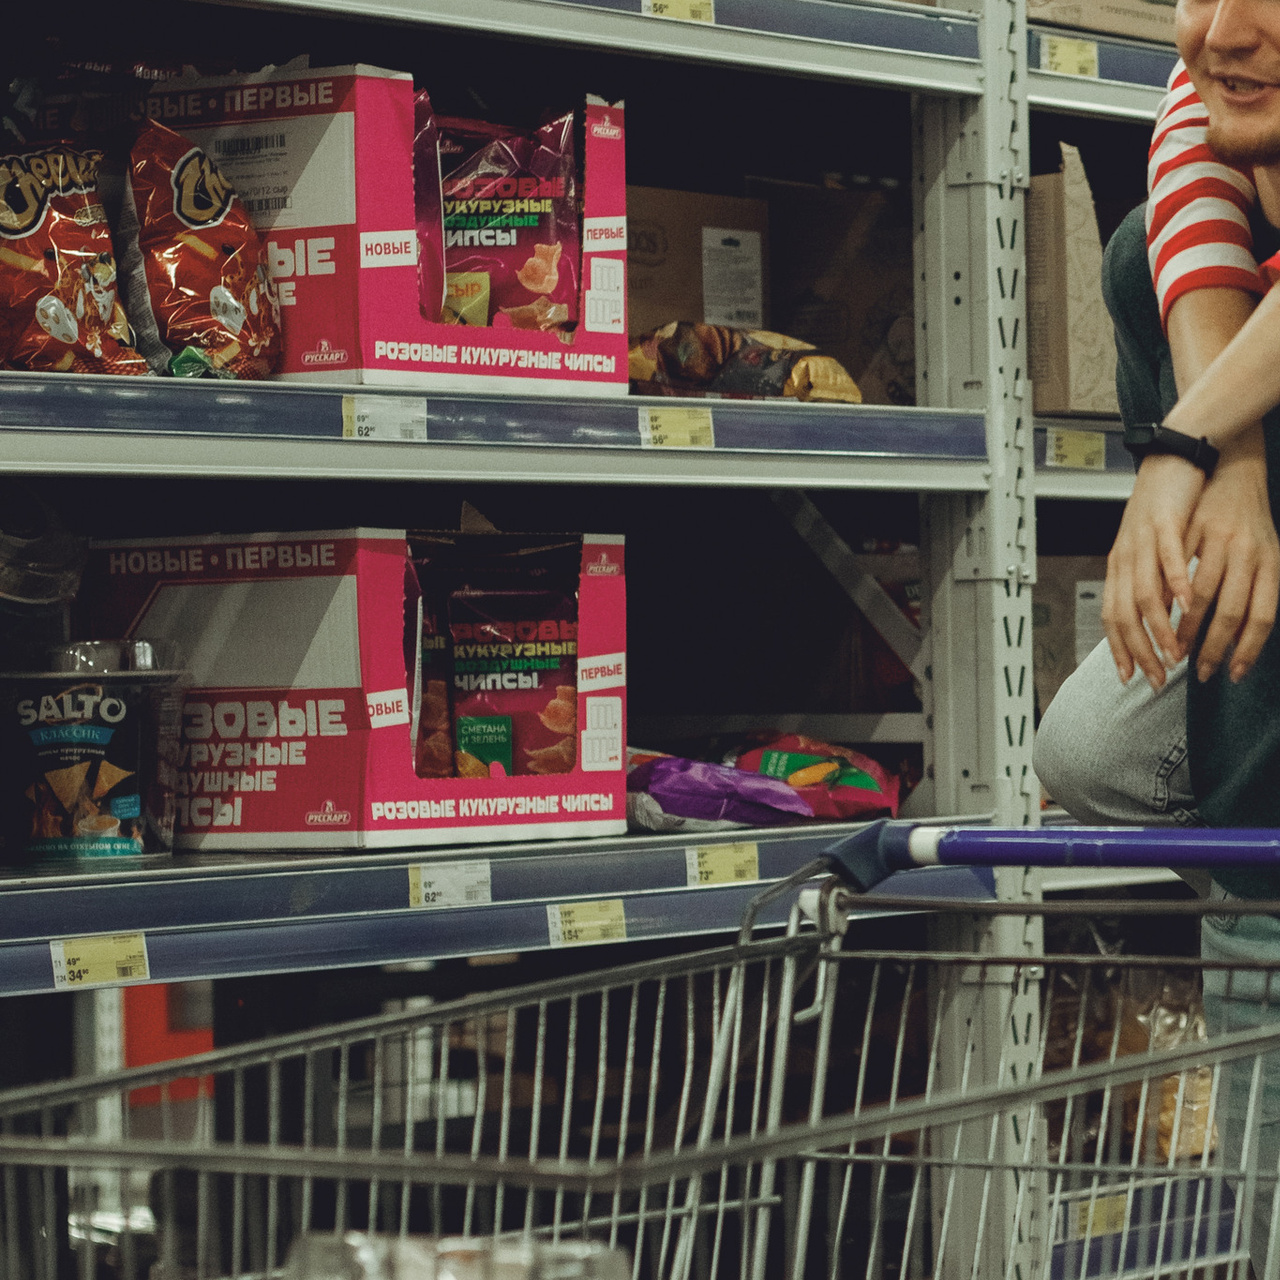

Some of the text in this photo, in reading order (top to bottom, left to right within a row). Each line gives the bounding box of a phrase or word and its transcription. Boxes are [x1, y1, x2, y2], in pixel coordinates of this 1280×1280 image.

[224, 81, 334, 113] ПЕРВЫЕ
[444, 199, 552, 214] УКУРУЗНЫЕ
[446, 228, 517, 246] ИПСЫ
[586, 226, 625, 240] ПЕРВЫЕ
[365, 241, 411, 256] НОВЫЕ
[304, 352, 346, 363] РУССКАРТ
[375, 340, 616, 373] РОЗОВЫЕ КУКУРУЗНЫЕ ЧИПСЫ
[109, 544, 336, 574] НОВЫЕ ПЕРВЫЕ
[453, 642, 577, 659] КУКУРУЗНЫЕ
[454, 657, 561, 672] ВОЗДУШНЫЕ
[580, 663, 622, 680] ПЕРВЫЕ
[454, 672, 539, 691] ЧИПСЫ
[17, 694, 126, 725] SALTO
[183, 699, 348, 739] ЗОВЫЕ
[40, 726, 101, 740] КЛАССИК
[461, 724, 507, 734] СМЕТАНА
[471, 734, 507, 744] ЗЕЛЕНЬ
[372, 793, 614, 820] РОЗОВЫЕ КУКУРУЗНЫЕ ЧИПСЫ
[307, 813, 348, 823] РУССКАРТ
